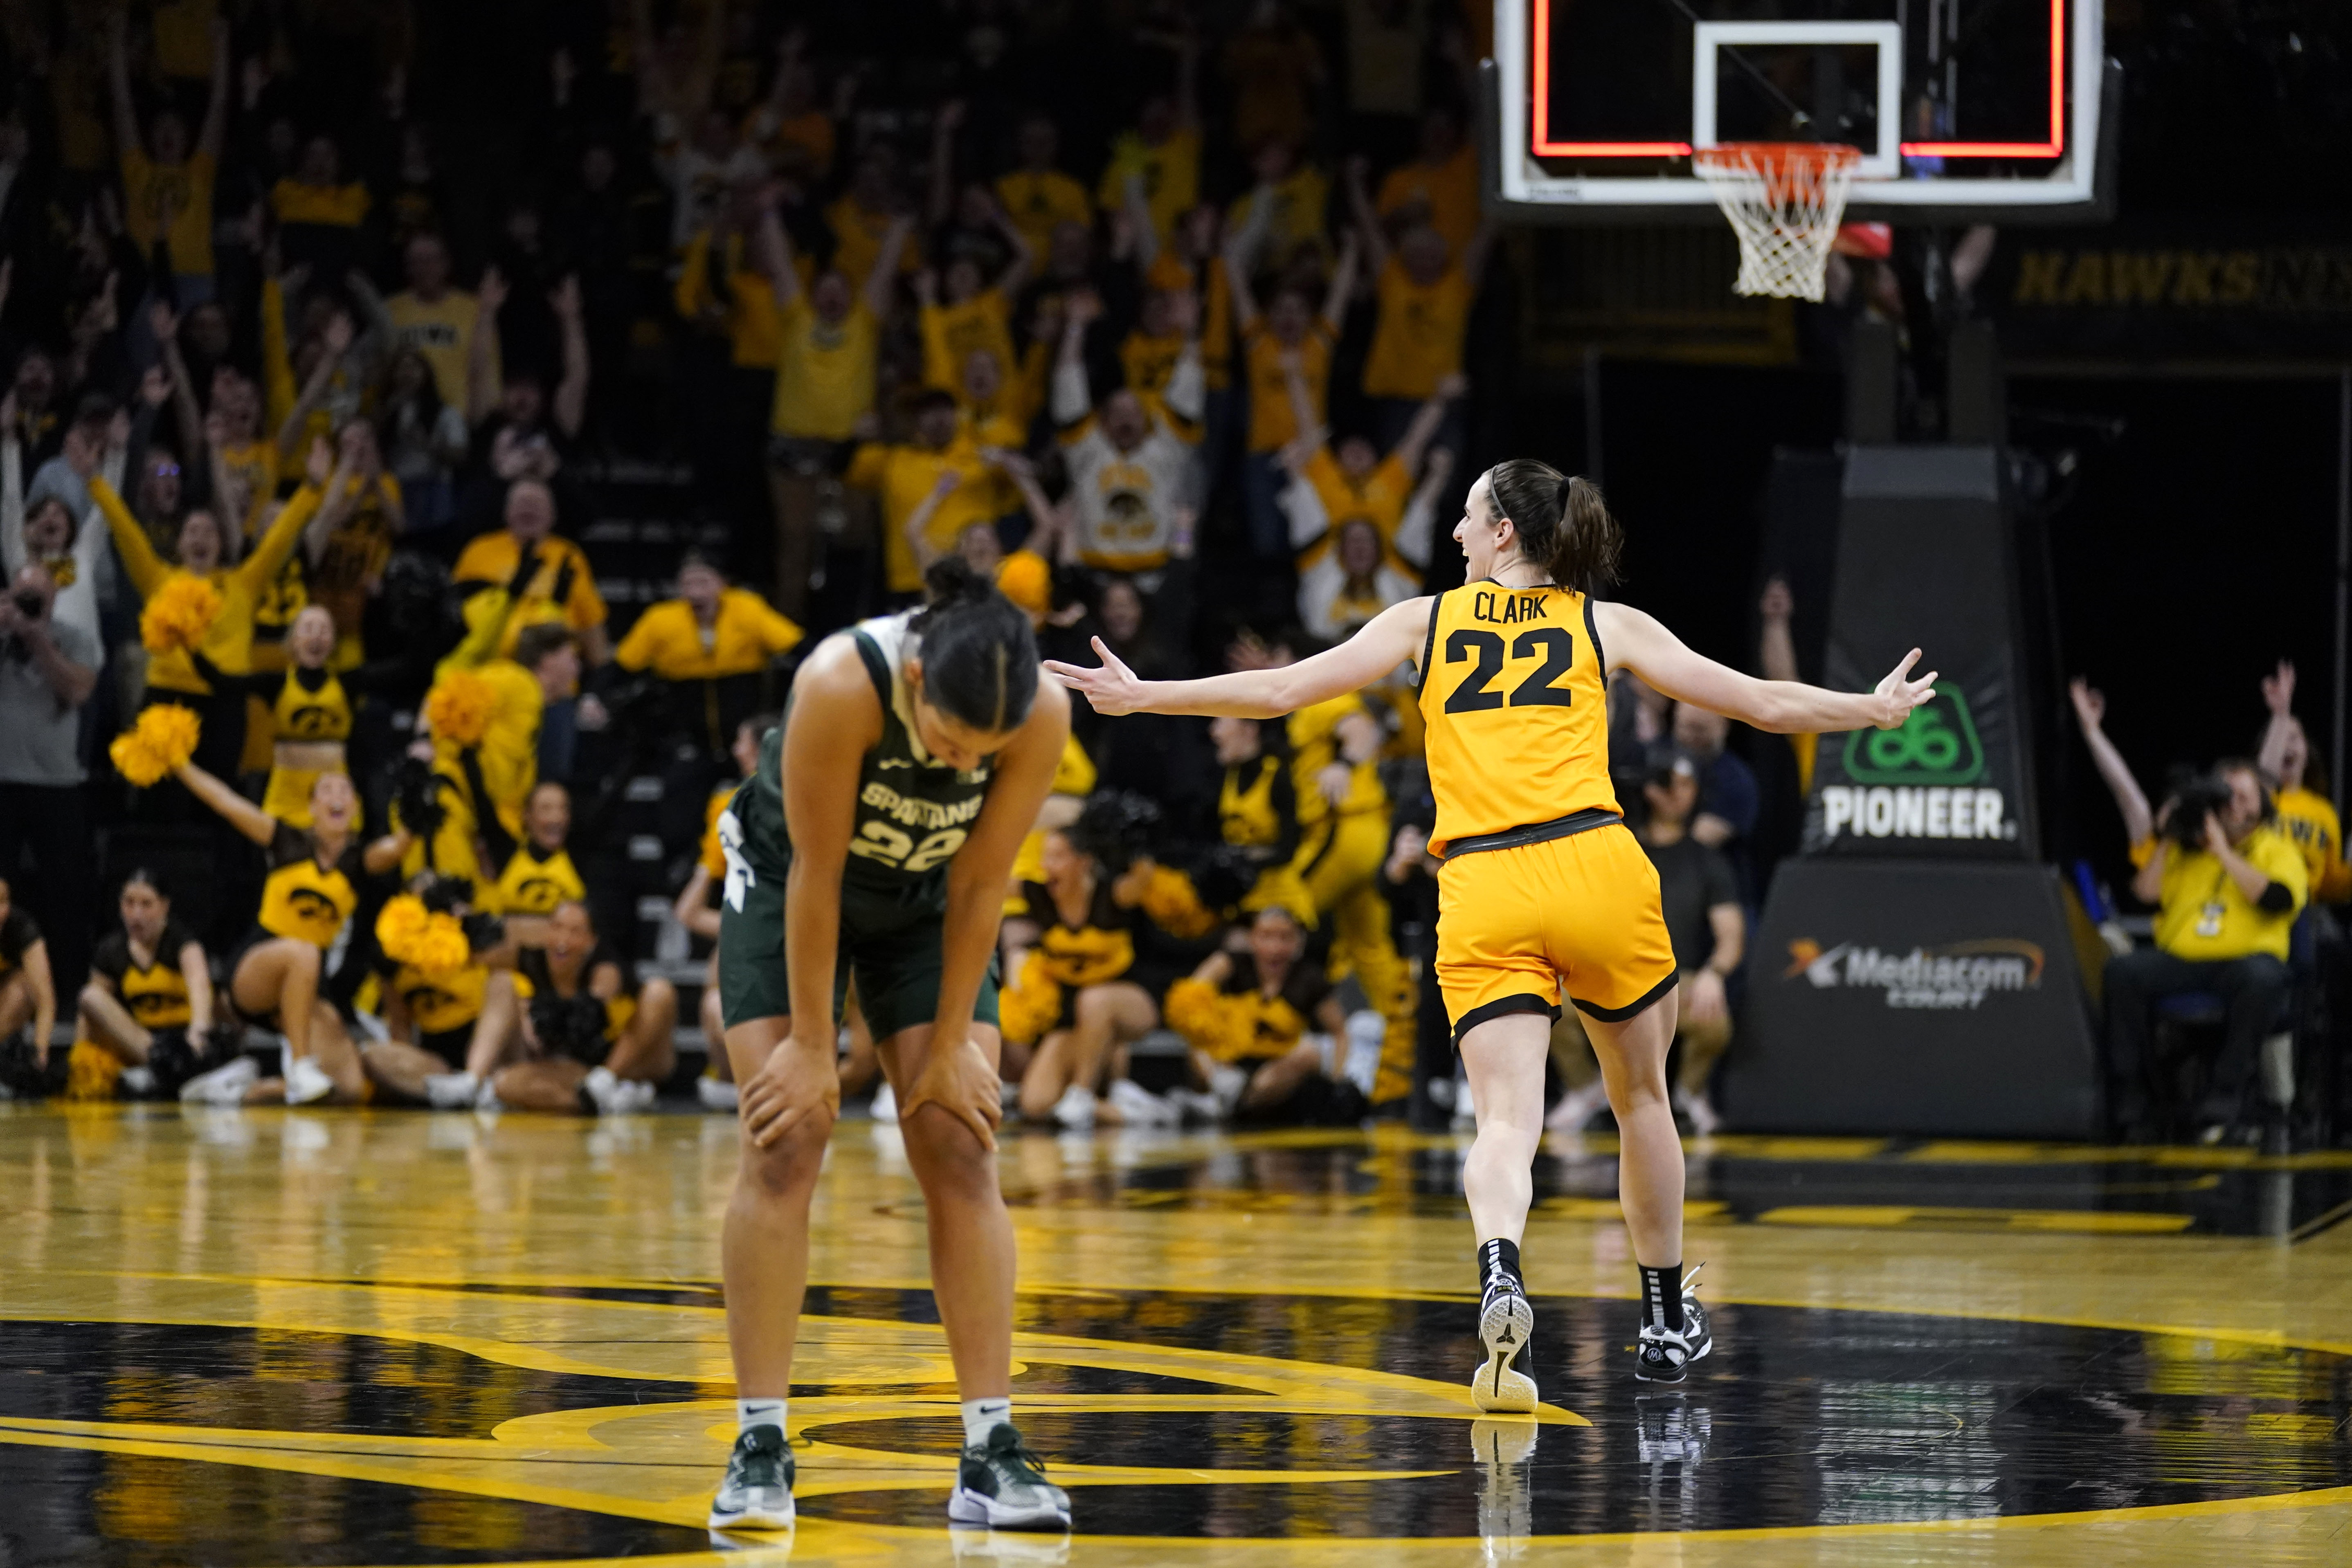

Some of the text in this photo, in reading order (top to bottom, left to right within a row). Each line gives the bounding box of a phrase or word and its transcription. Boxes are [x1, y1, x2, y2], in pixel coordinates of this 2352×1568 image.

[1475, 592, 1549, 623] CLARK
[1444, 627, 1572, 714] 22
[1822, 785, 2003, 839] PIONEER
[849, 820, 968, 872] 22
[1846, 946, 2025, 991] Mediacom
